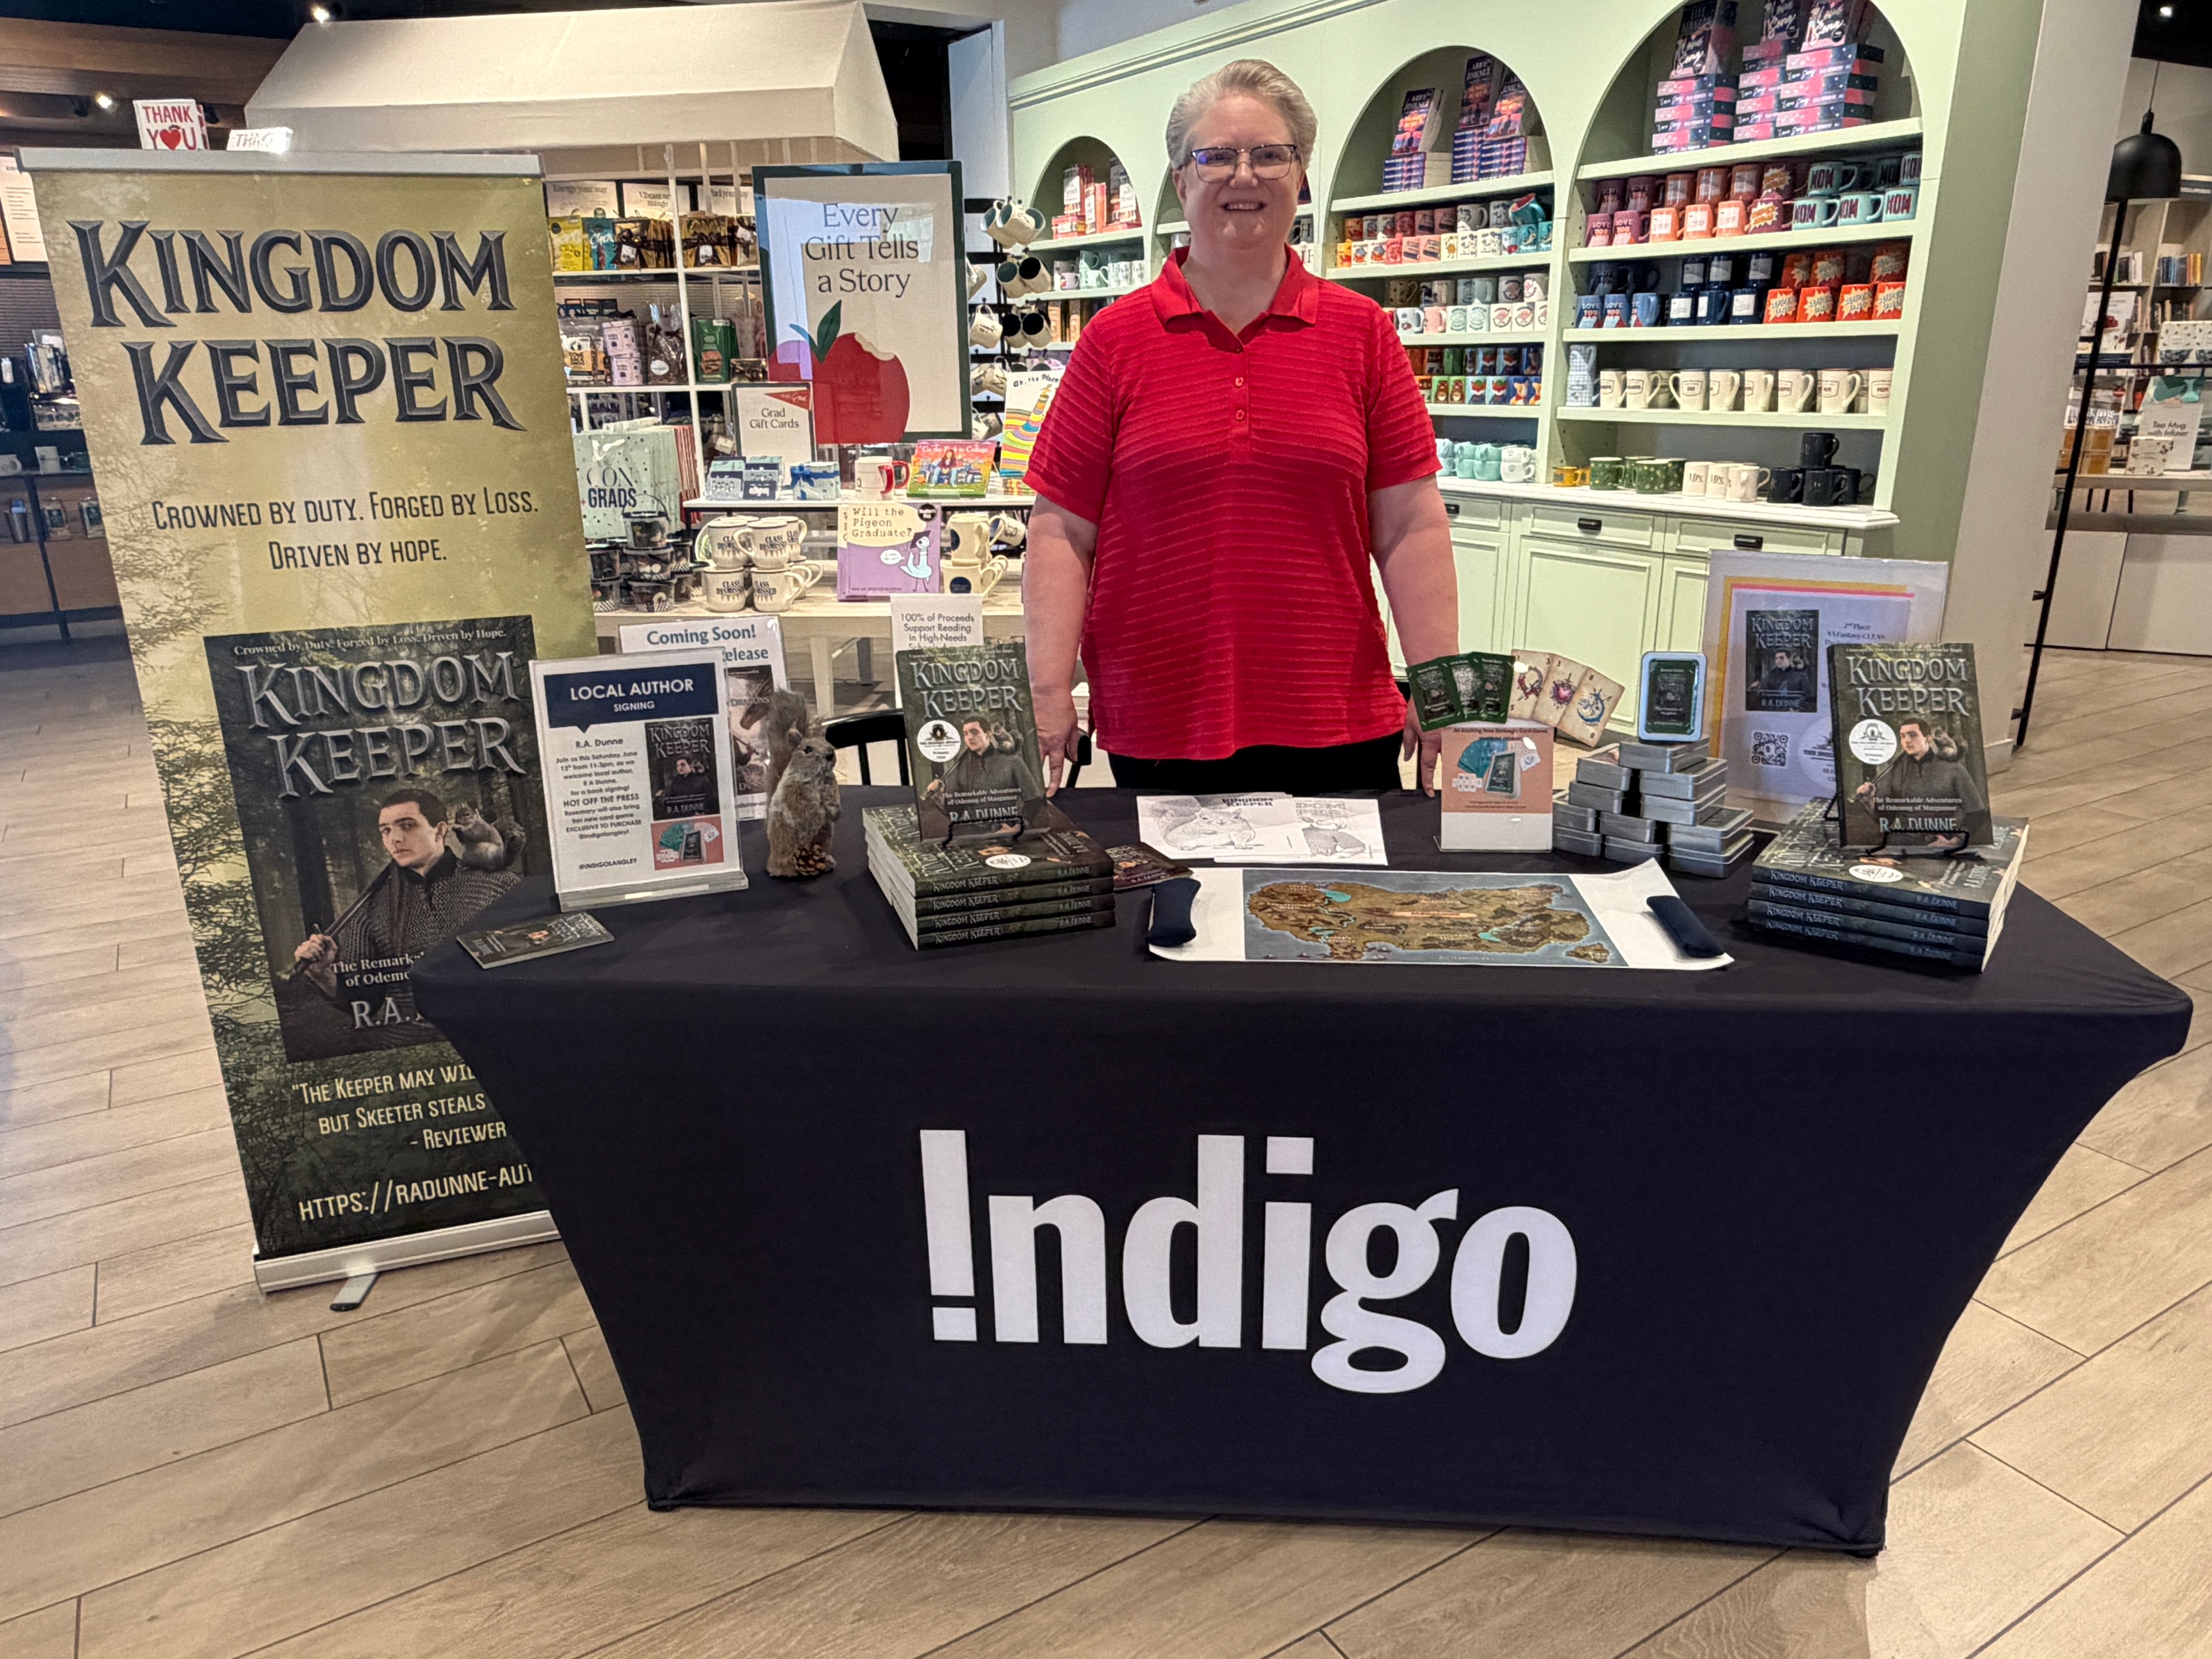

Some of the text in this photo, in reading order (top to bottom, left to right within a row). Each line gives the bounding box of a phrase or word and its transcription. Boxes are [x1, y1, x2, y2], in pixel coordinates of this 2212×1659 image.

[142, 106, 194, 123] THANK
[823, 203, 899, 232] Every
[806, 234, 919, 261] Gift Tells
[67, 220, 516, 327] KINGDOM
[817, 268, 911, 298] a Story
[1041, 374, 1059, 382] Place
[120, 336, 528, 445] KEEPER
[761, 407, 786, 418] Grad
[749, 419, 799, 429] Gift Cards
[2168, 421, 2187, 429] Mug
[588, 488, 637, 508] GRADS
[853, 507, 904, 516] Will the
[853, 518, 892, 528] Pigeon
[852, 528, 912, 537] Graduate?
[901, 613, 975, 622] 100% of Proceeds
[1752, 618, 1813, 632] KINGDOM
[647, 624, 756, 645] Coming Soon!
[904, 623, 971, 634] Support Reading
[233, 643, 285, 656] Crowned
[336, 637, 374, 650] Forged
[423, 631, 459, 643] Driven
[461, 630, 474, 642] by
[476, 628, 506, 640] Hope.
[919, 633, 967, 643] High-Needs
[1755, 634, 1812, 649] KEEPER
[909, 658, 1020, 688] KINGDOM
[1846, 656, 1968, 684] KINGDOM
[234, 652, 520, 729] KINGDOM
[570, 679, 694, 700] LOCAL AUTHOR
[613, 700, 656, 713] SIGNING
[921, 685, 1023, 718] KEEPER
[1855, 687, 1970, 717] KEEPER
[650, 724, 710, 742] KINGDOM
[595, 738, 624, 747] Dunne
[654, 739, 710, 758] KEEPER
[267, 717, 527, 798] KEEPER
[582, 797, 598, 805] OFF
[616, 793, 639, 802] PRESS
[566, 824, 599, 832] EXCLUSIVE
[610, 819, 641, 827] PURCHASE
[331, 959, 358, 975] The
[346, 975, 359, 988] of
[351, 997, 411, 1030] R.A.
